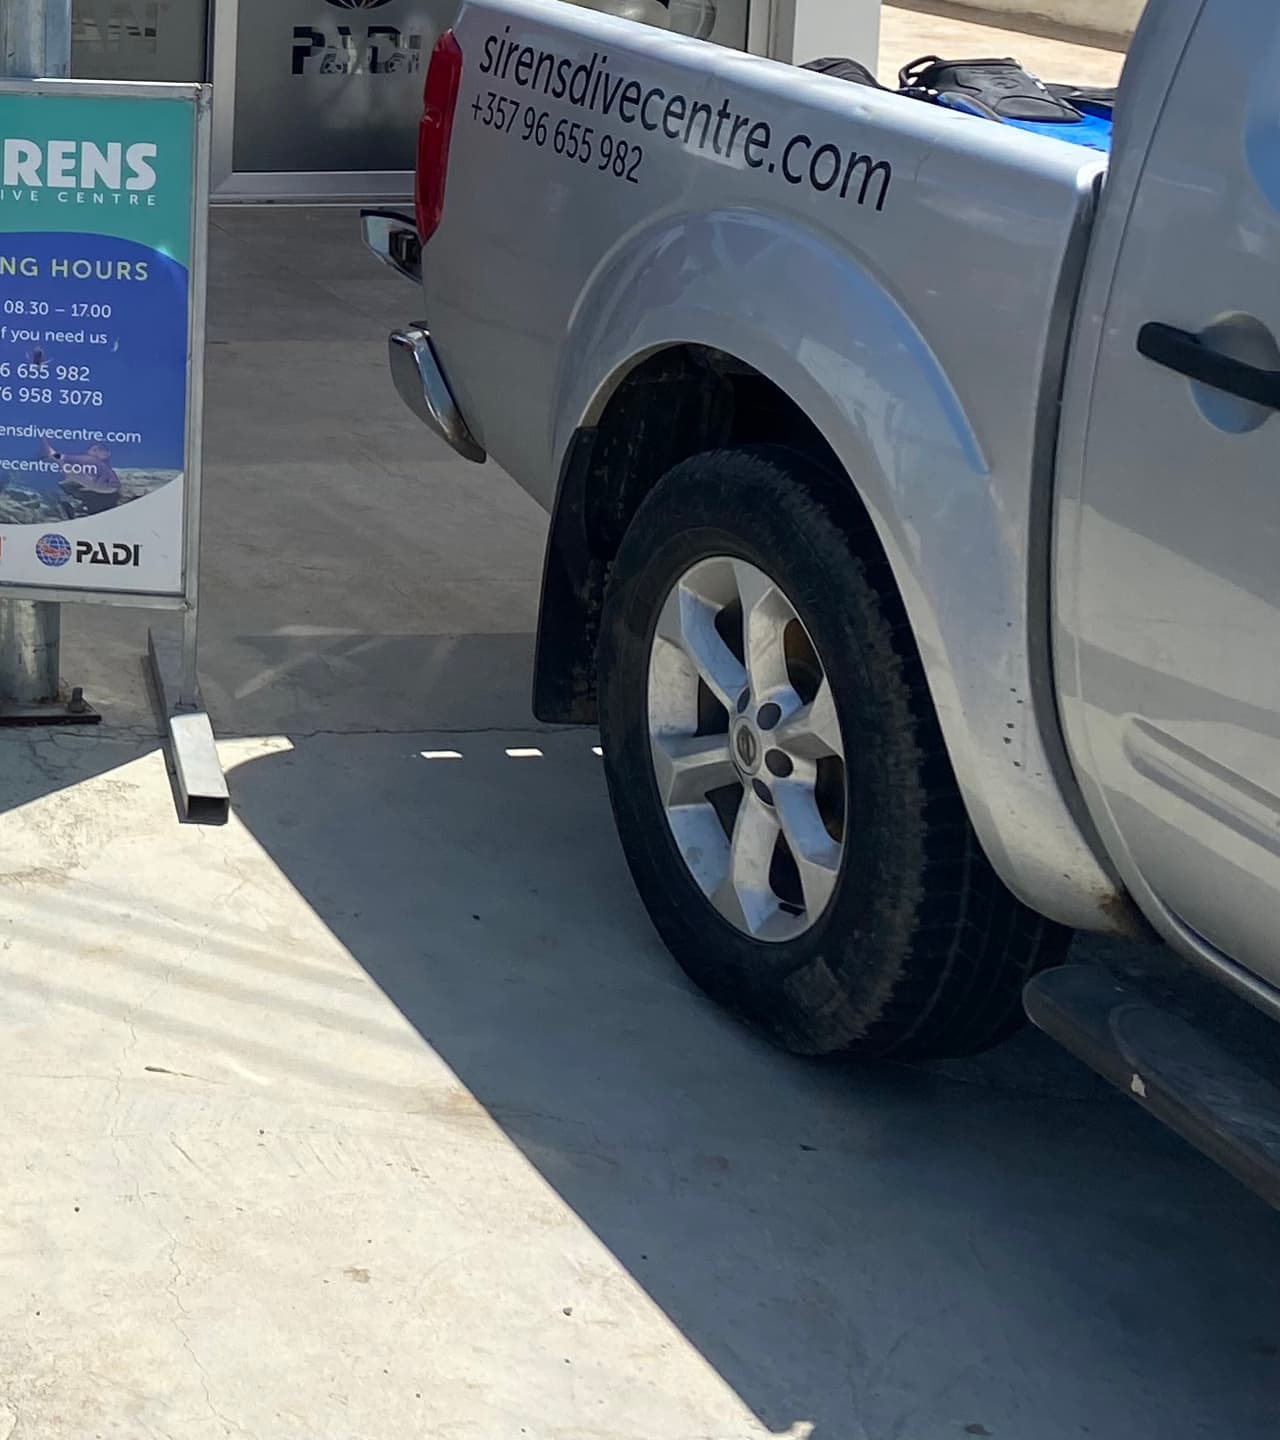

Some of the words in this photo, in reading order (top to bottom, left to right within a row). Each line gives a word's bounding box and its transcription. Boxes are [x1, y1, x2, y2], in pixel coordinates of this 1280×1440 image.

[478, 25, 892, 213] sirensdivecentre.com
[470, 91, 520, 135] +357
[521, 105, 549, 147] 96
[553, 117, 595, 164] 655
[598, 133, 643, 185] 982
[57, 190, 157, 206] CENTRE
[51, 258, 148, 281] HOURS
[3, 300, 49, 315] 08.30
[71, 303, 112, 318] 17.00
[10, 328, 40, 344] you
[44, 330, 85, 344] need
[89, 332, 108, 344] us
[16, 363, 50, 379] 655
[55, 365, 91, 382] 982
[18, 387, 53, 404] 958
[59, 389, 104, 406] 3078
[76, 540, 140, 566] PADI
